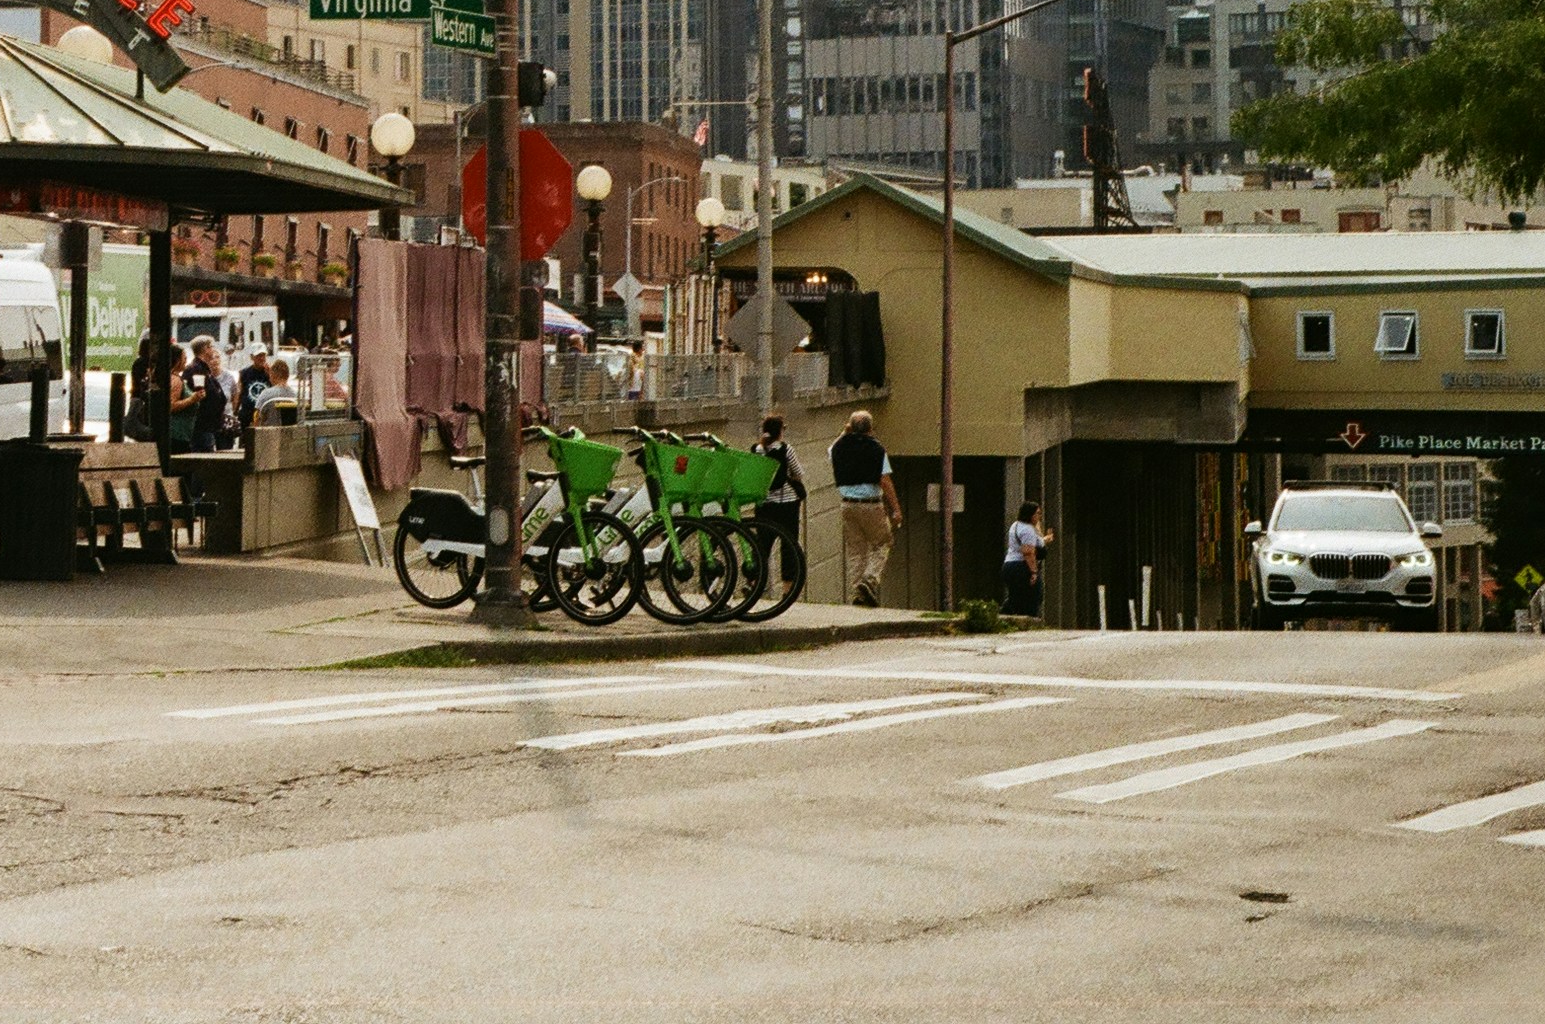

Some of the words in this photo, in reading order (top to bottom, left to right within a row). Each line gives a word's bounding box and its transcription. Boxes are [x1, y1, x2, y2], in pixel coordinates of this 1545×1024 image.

[434, 11, 476, 45] Western
[480, 27, 494, 48] Ave
[87, 297, 138, 338] Deliver
[1379, 435, 1414, 449] Pike
[1418, 435, 1461, 449] Place
[1466, 435, 1526, 450] Market
